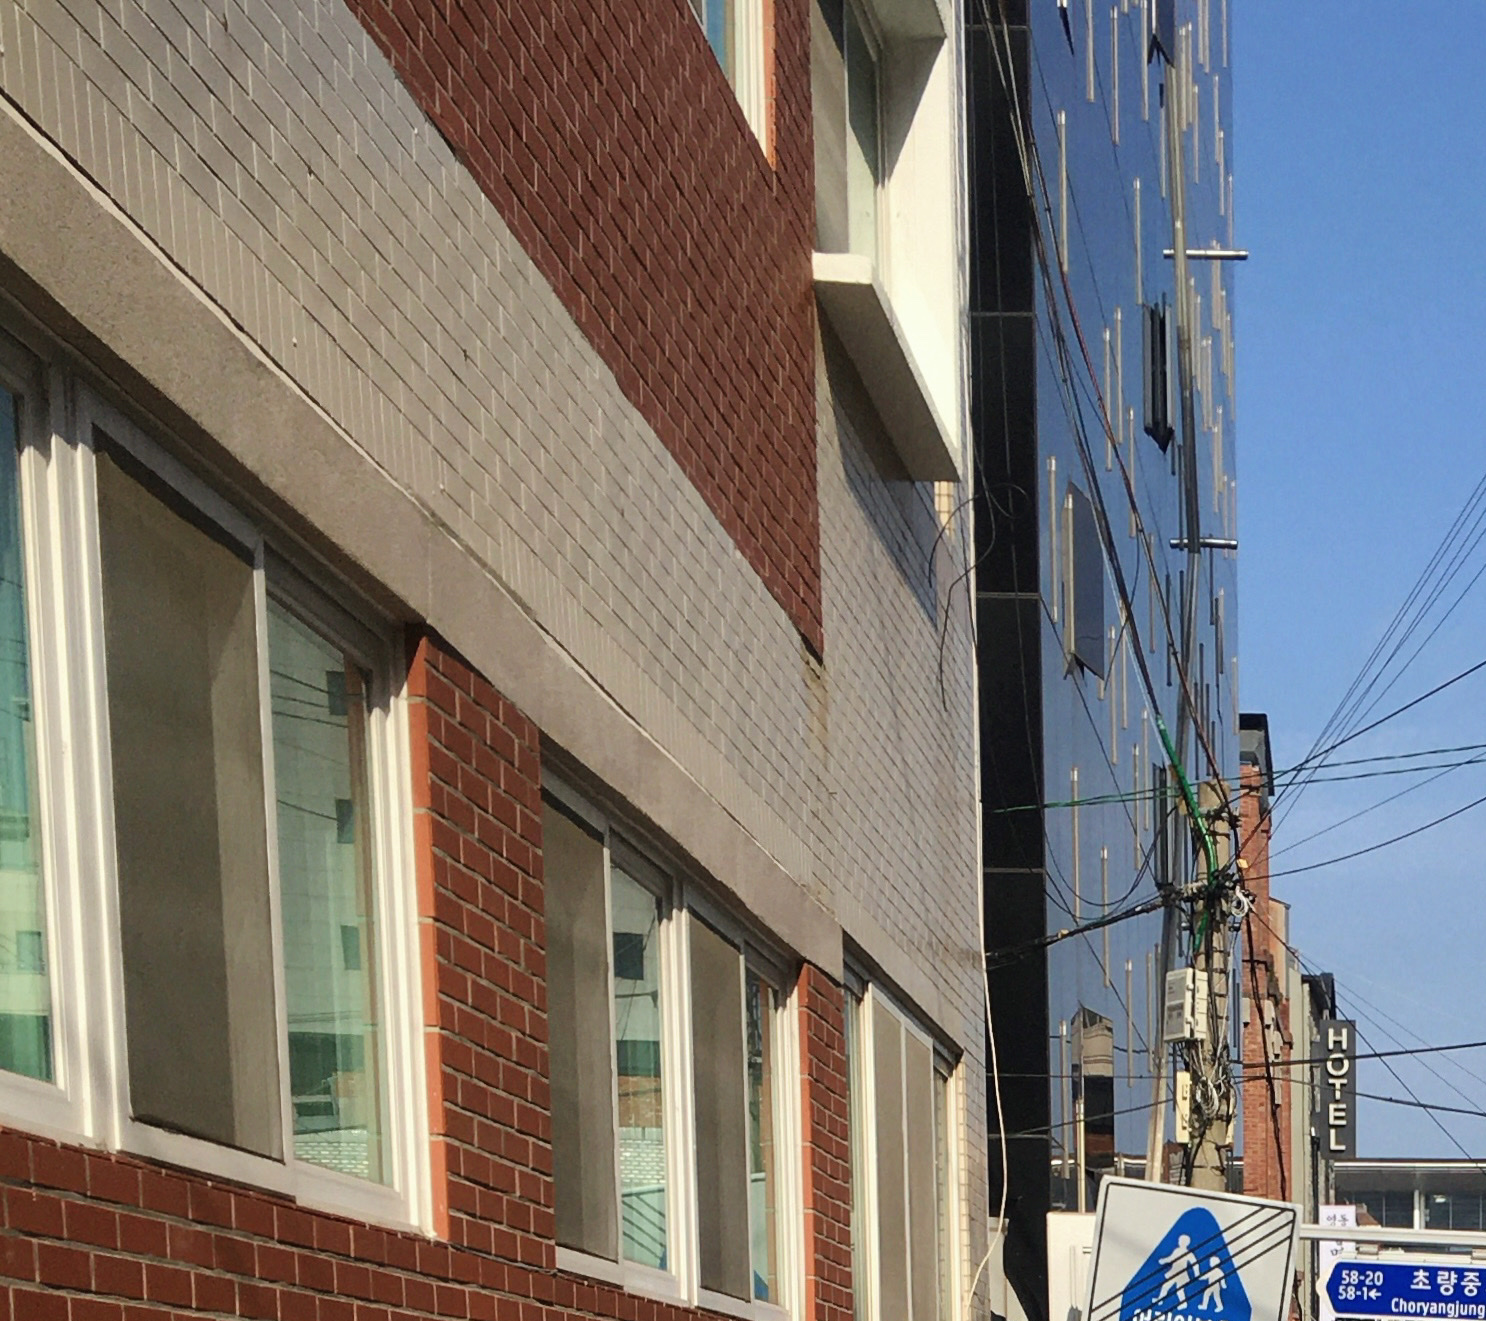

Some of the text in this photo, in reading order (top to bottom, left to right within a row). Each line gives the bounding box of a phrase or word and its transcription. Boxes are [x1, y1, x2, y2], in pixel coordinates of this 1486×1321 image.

[1326, 1027, 1350, 1152] HOTEL
[1341, 1270, 1384, 1286] 58-20
[1338, 1286, 1368, 1301] 58-1
